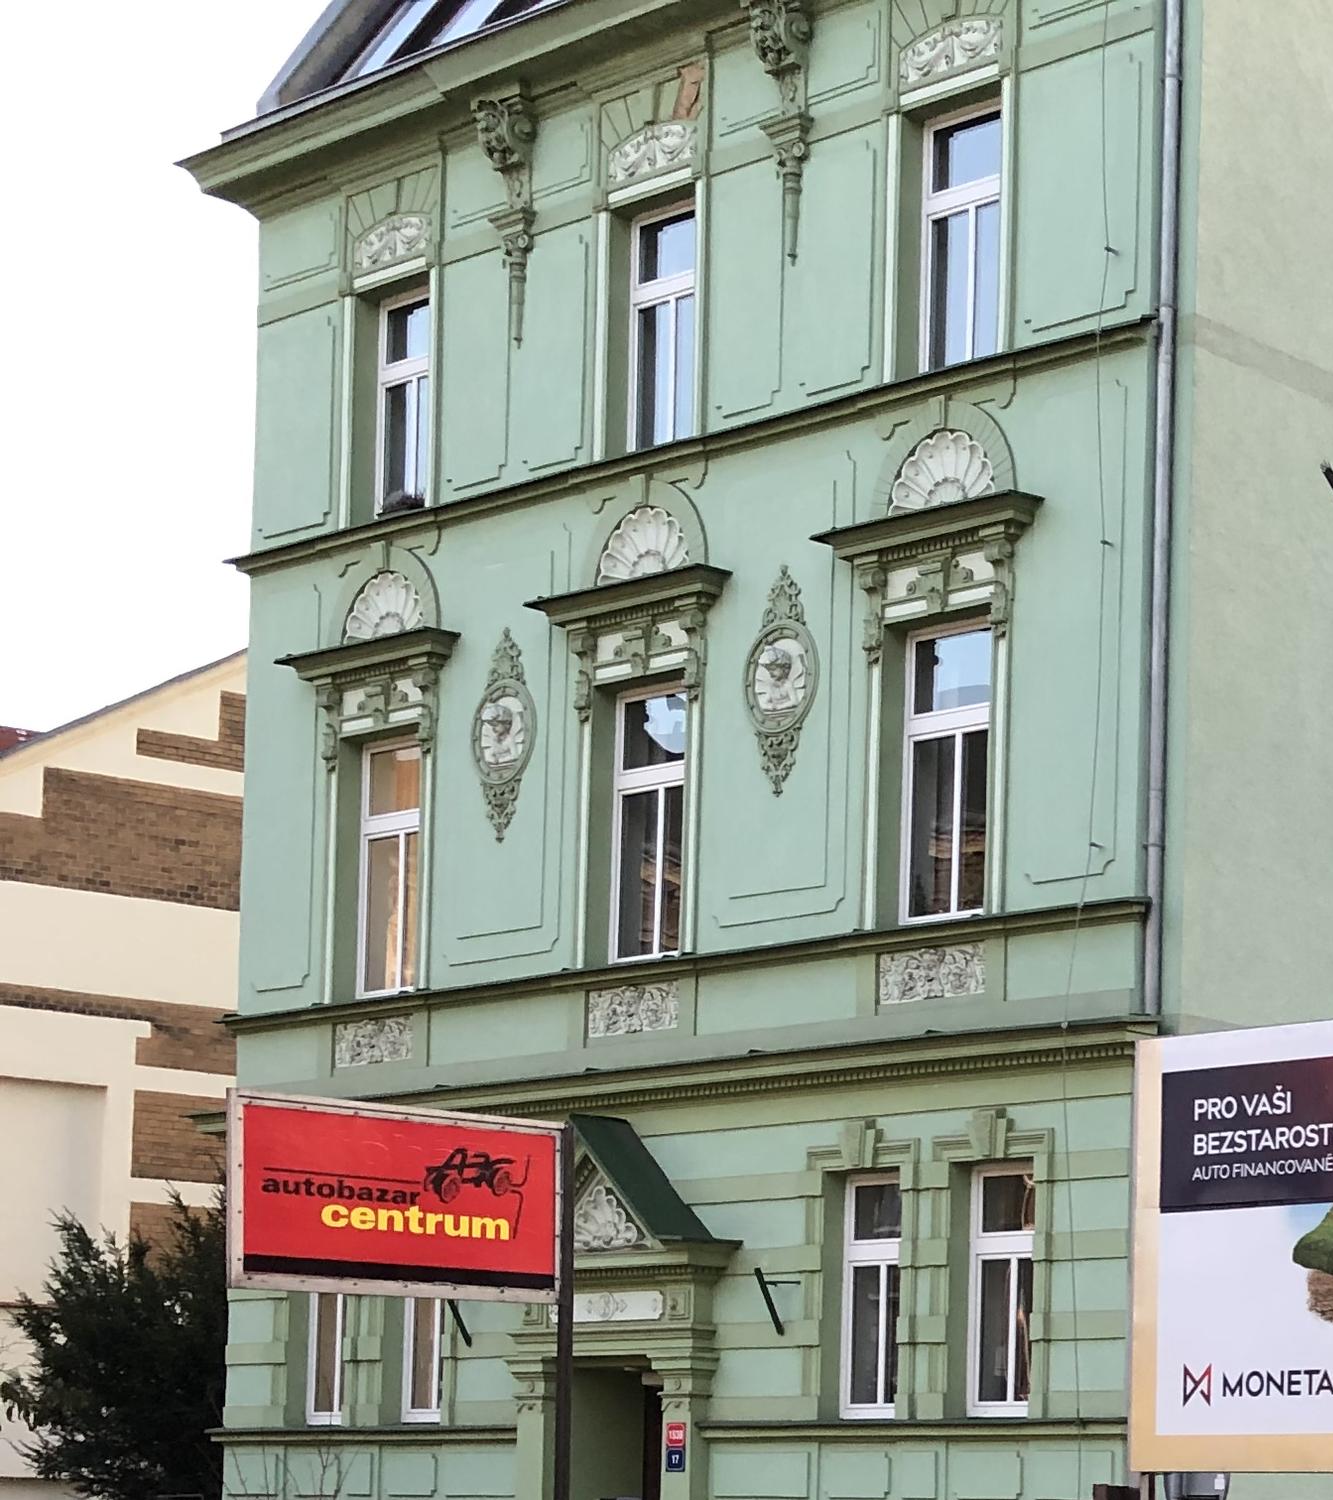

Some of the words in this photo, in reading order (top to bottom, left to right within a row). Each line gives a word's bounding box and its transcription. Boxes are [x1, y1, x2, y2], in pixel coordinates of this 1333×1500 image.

[1194, 1096, 1237, 1121] PRO
[1241, 1086, 1291, 1116] VAŠI
[1192, 1165, 1230, 1180] AUTO
[1233, 1154, 1333, 1177] FINANCOVANÉ
[261, 1175, 421, 1205] autobazar
[321, 1205, 509, 1240] centrum
[671, 1454, 680, 1464] 17
